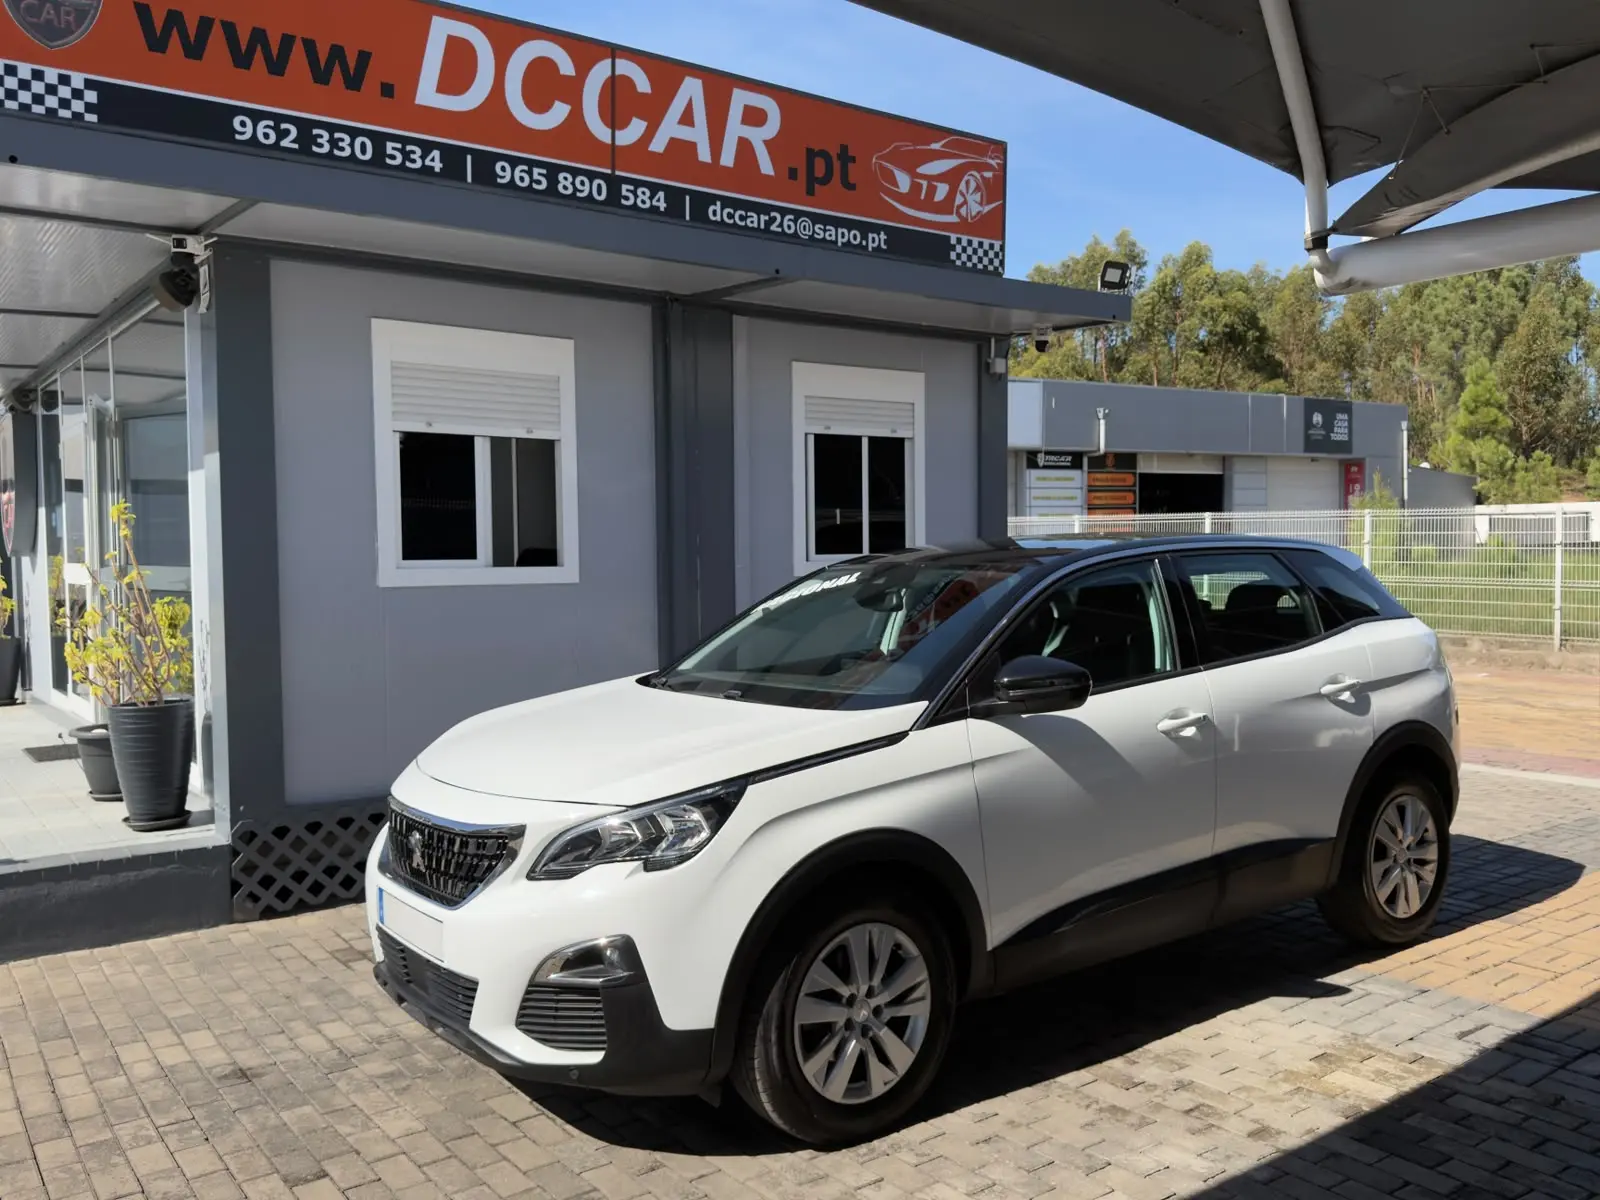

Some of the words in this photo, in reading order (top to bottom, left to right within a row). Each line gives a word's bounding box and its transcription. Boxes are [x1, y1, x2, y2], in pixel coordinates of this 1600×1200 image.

[232, 115, 299, 149] 962
[311, 128, 373, 161] 330
[384, 143, 444, 173] 534
[495, 161, 548, 191] 965
[557, 172, 607, 201] 890
[620, 184, 667, 212] 584
[708, 200, 888, 251] dccar26@sapo.pt
